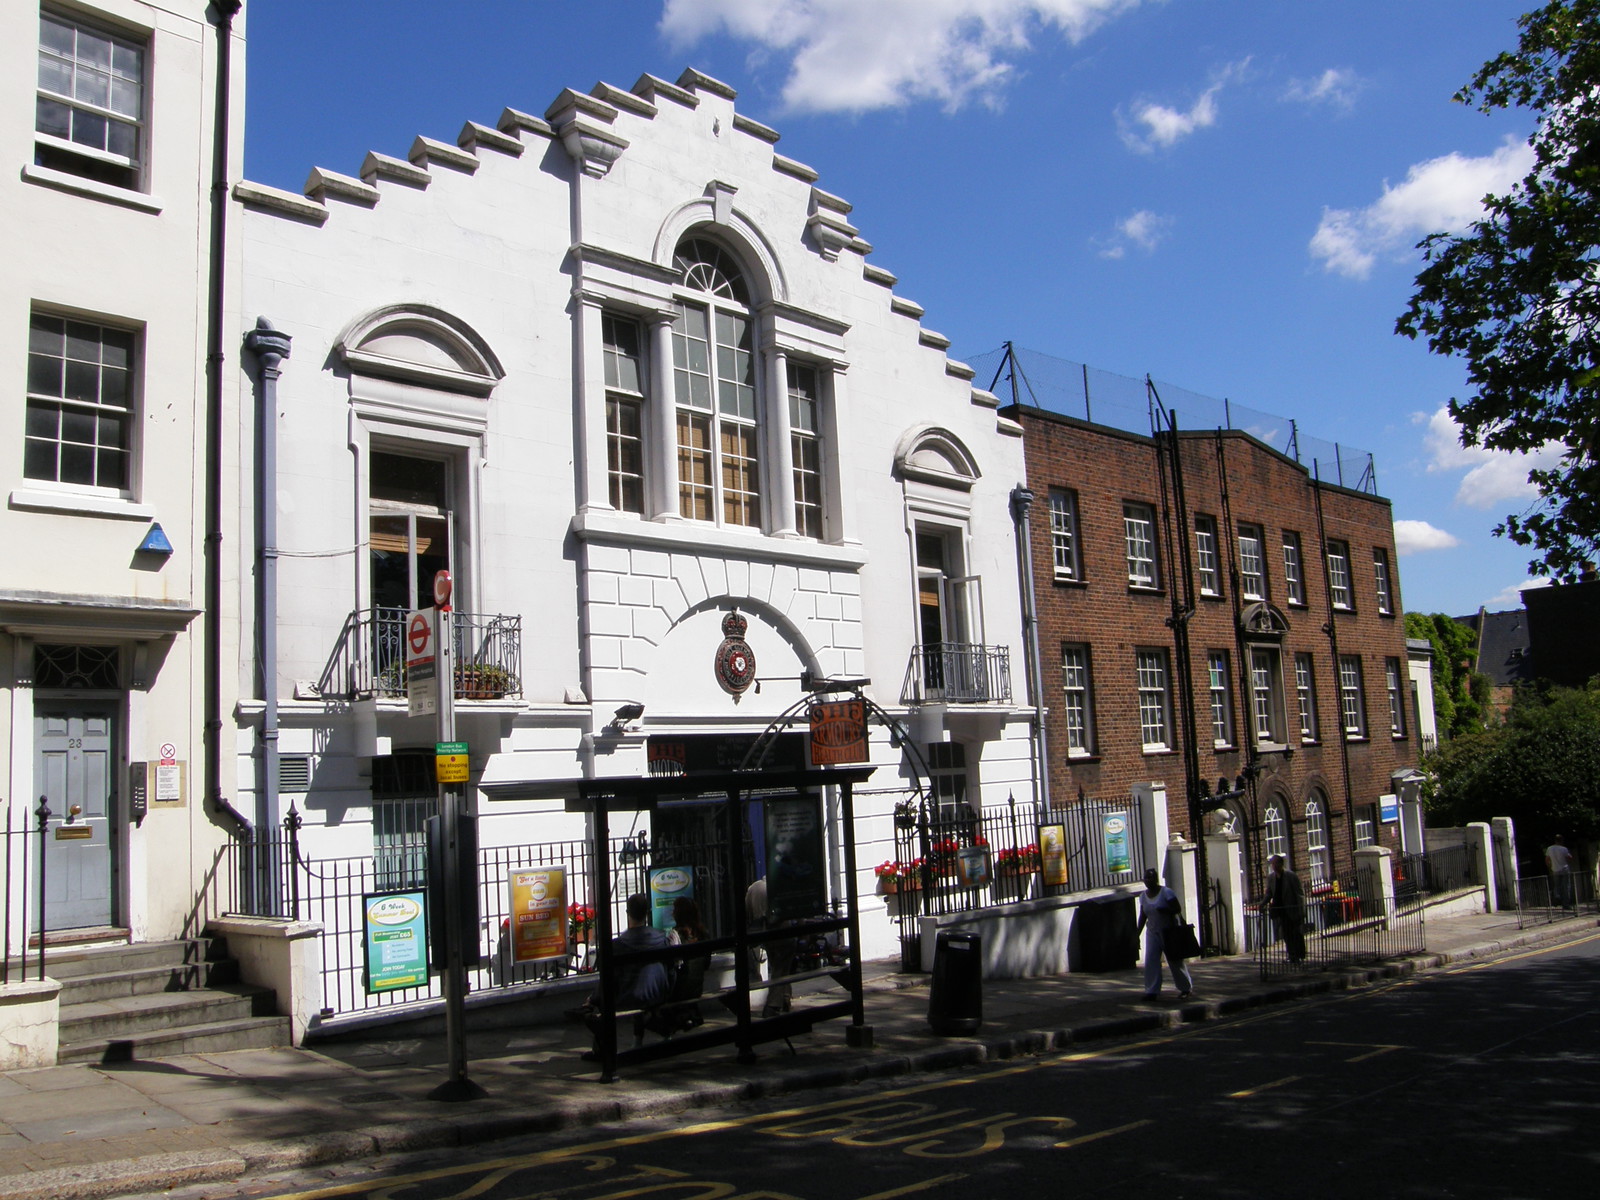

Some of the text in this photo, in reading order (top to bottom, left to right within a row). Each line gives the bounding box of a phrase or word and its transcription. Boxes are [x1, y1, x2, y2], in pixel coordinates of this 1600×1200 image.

[68, 738, 82, 748] 23
[813, 721, 863, 747] ARMOURY
[845, 740, 865, 761] CLUB
[648, 758, 685, 778] RMOURY
[535, 912, 550, 920] BED
[757, 1101, 1077, 1158] BUS
